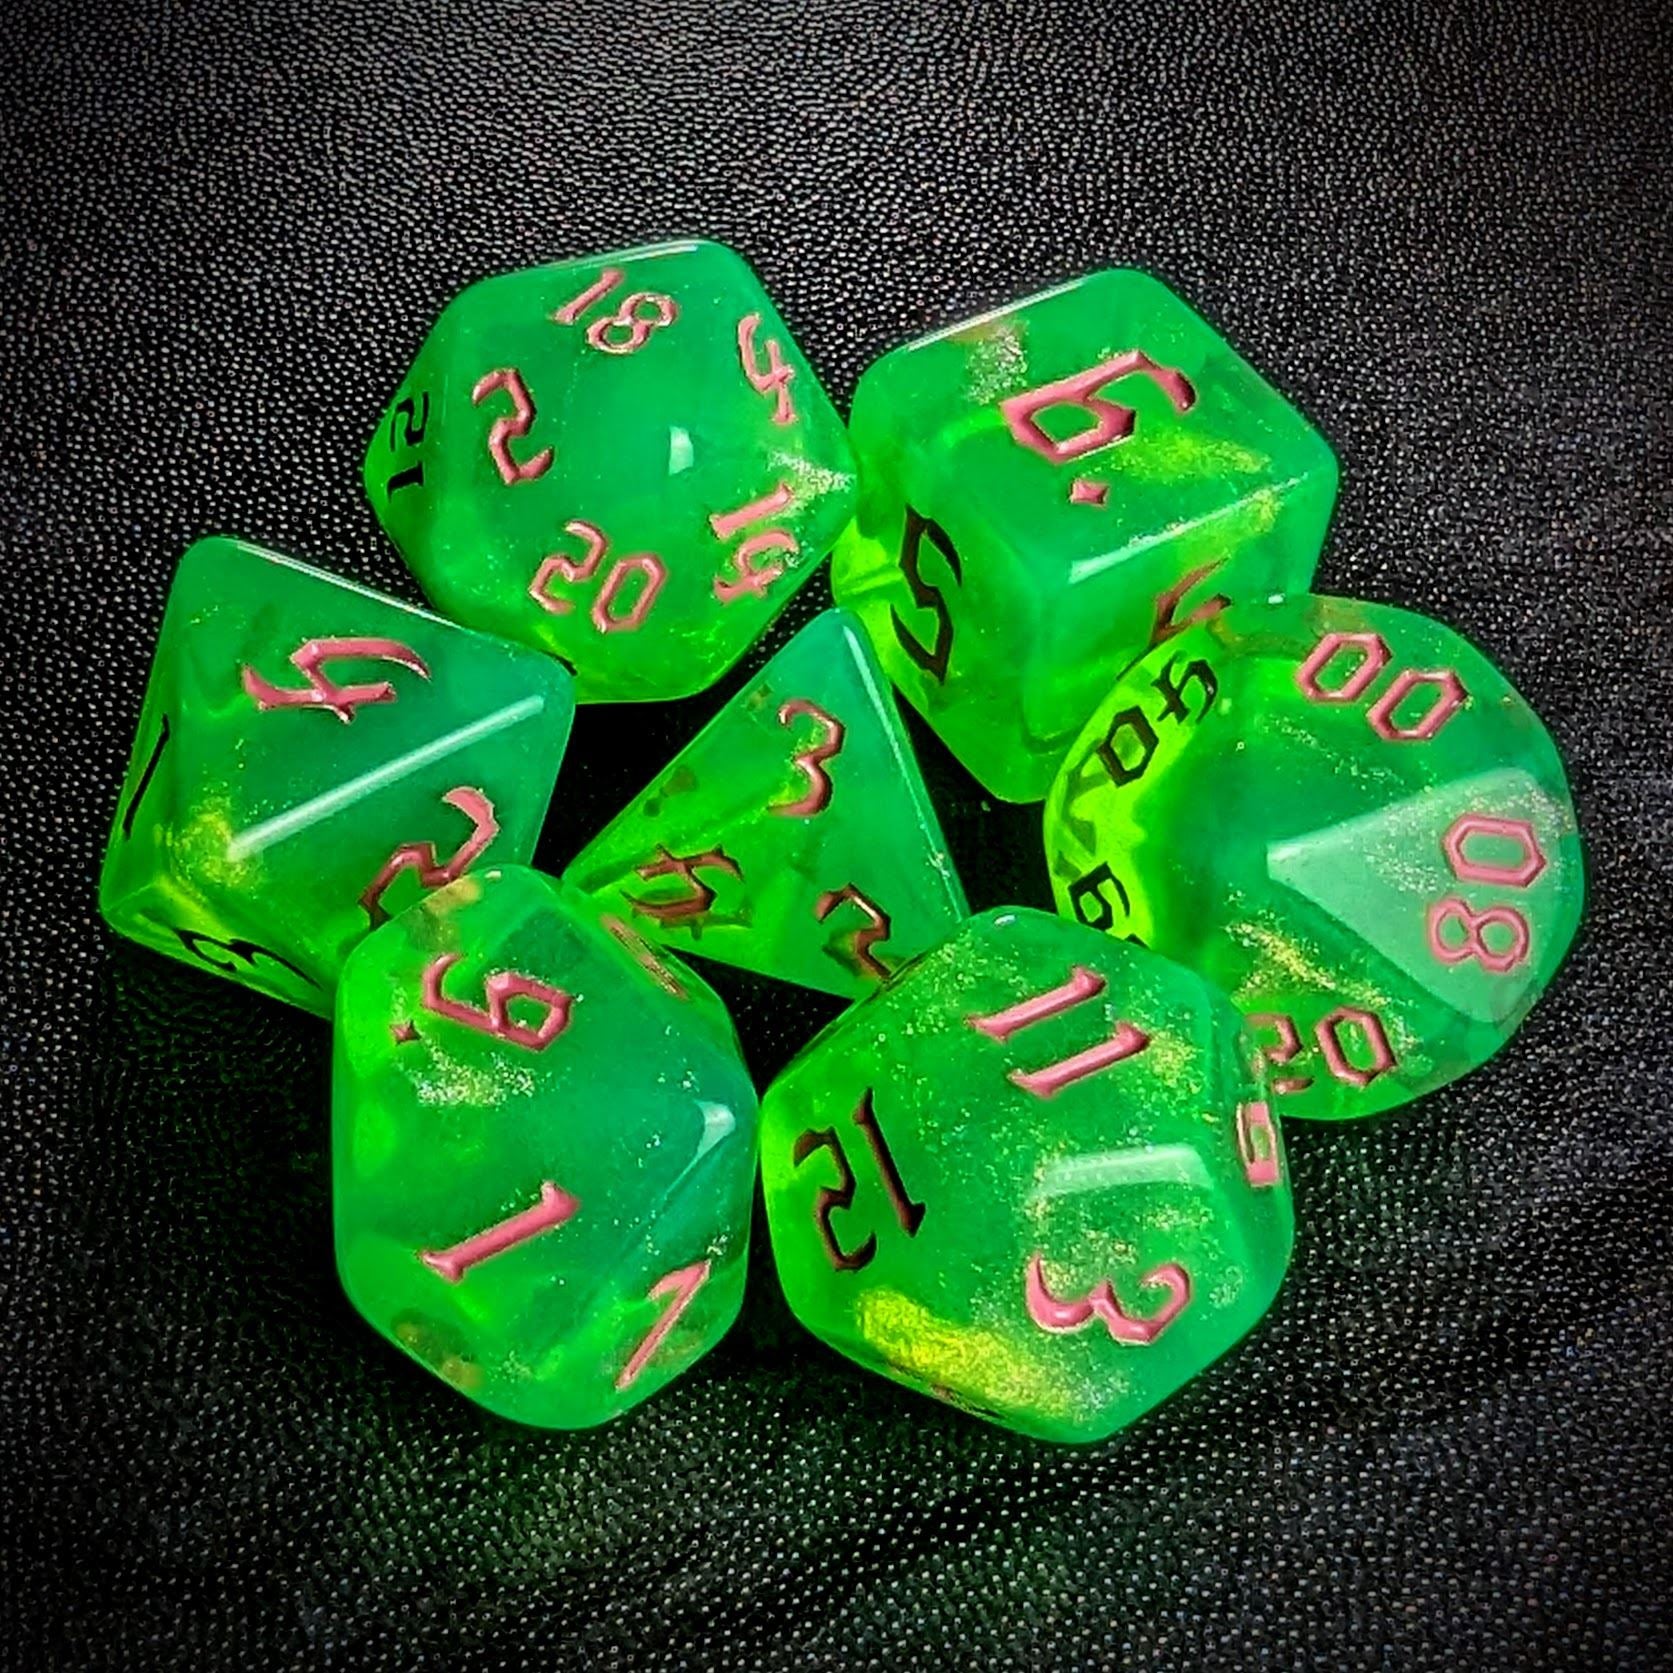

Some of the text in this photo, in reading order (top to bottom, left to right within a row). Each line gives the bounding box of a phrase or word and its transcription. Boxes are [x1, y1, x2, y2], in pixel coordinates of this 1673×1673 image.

[549, 267, 679, 355] 18
[736, 312, 797, 427] 4
[386, 390, 430, 503] 12
[470, 366, 556, 487] 2
[528, 519, 669, 635] 20
[890, 502, 963, 687] 5
[241, 636, 432, 726] 4
[1100, 648, 1219, 788] 40
[1294, 632, 1469, 743] 00
[765, 698, 846, 818] 3
[357, 785, 502, 931] 2
[1426, 811, 1548, 973] 80
[964, 964, 1153, 1100] 11
[419, 1178, 582, 1286] 1
[792, 1086, 928, 1273] 12
[613, 1259, 713, 1389] 7
[1024, 1251, 1193, 1347] 3
